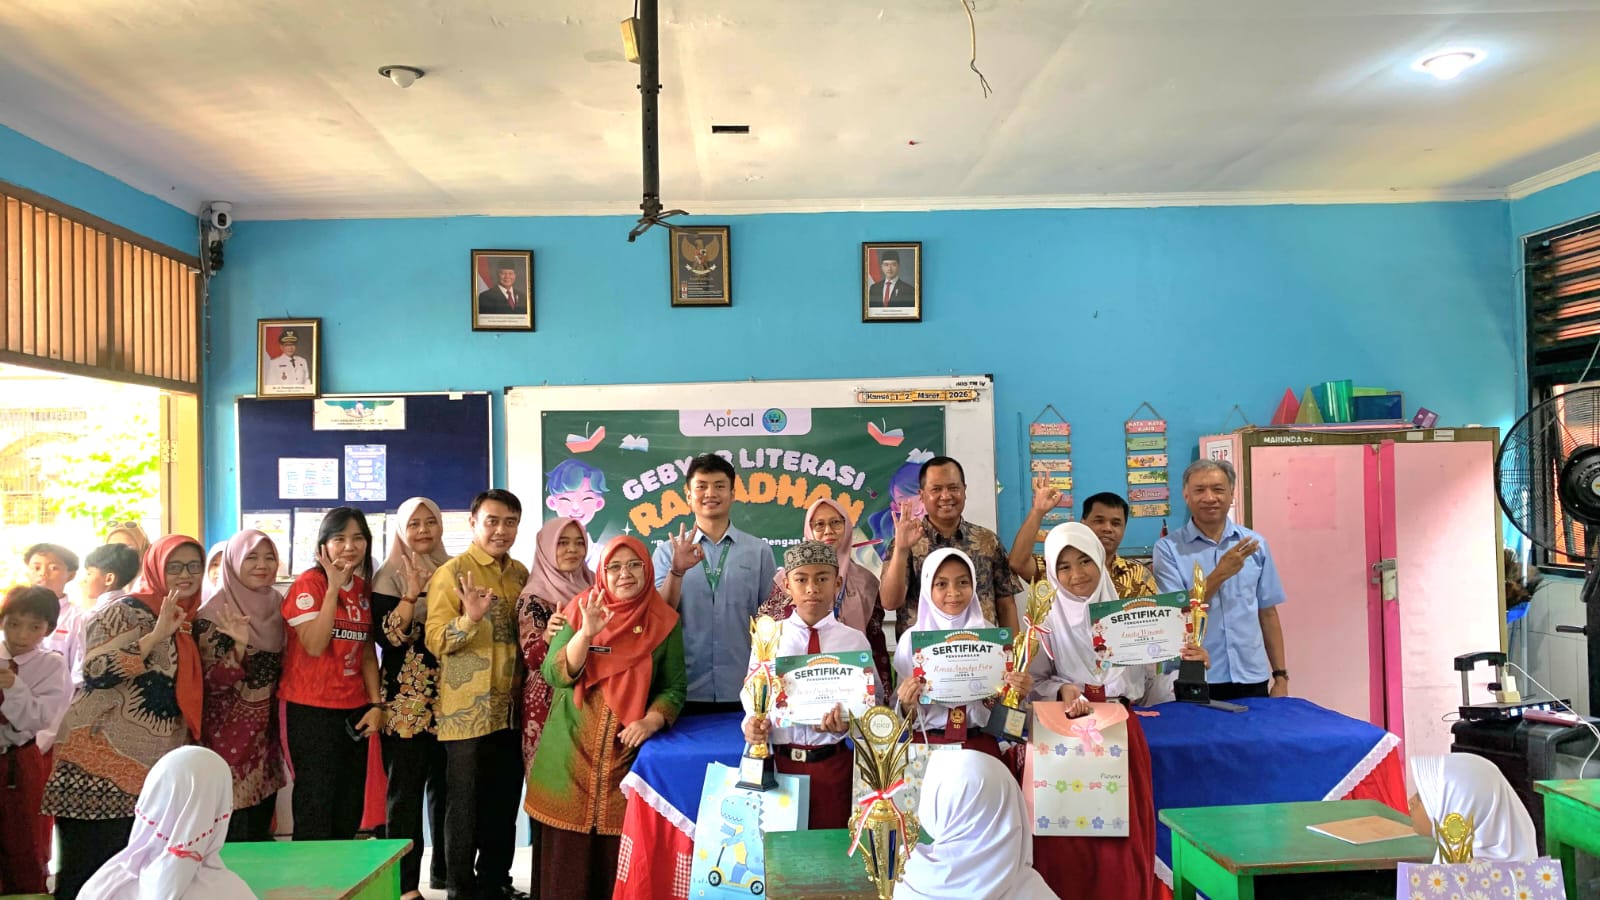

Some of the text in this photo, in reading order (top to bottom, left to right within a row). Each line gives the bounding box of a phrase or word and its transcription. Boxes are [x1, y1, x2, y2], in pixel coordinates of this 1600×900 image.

[704, 409, 754, 431] Apical
[622, 448, 866, 500] GEBYR LITERASI
[629, 472, 865, 537] RAADHAN
[1110, 609, 1172, 624] SERTIFIKAT
[932, 644, 994, 656] SERTIFIKAT
[794, 667, 854, 680] SERTIFIKAT
